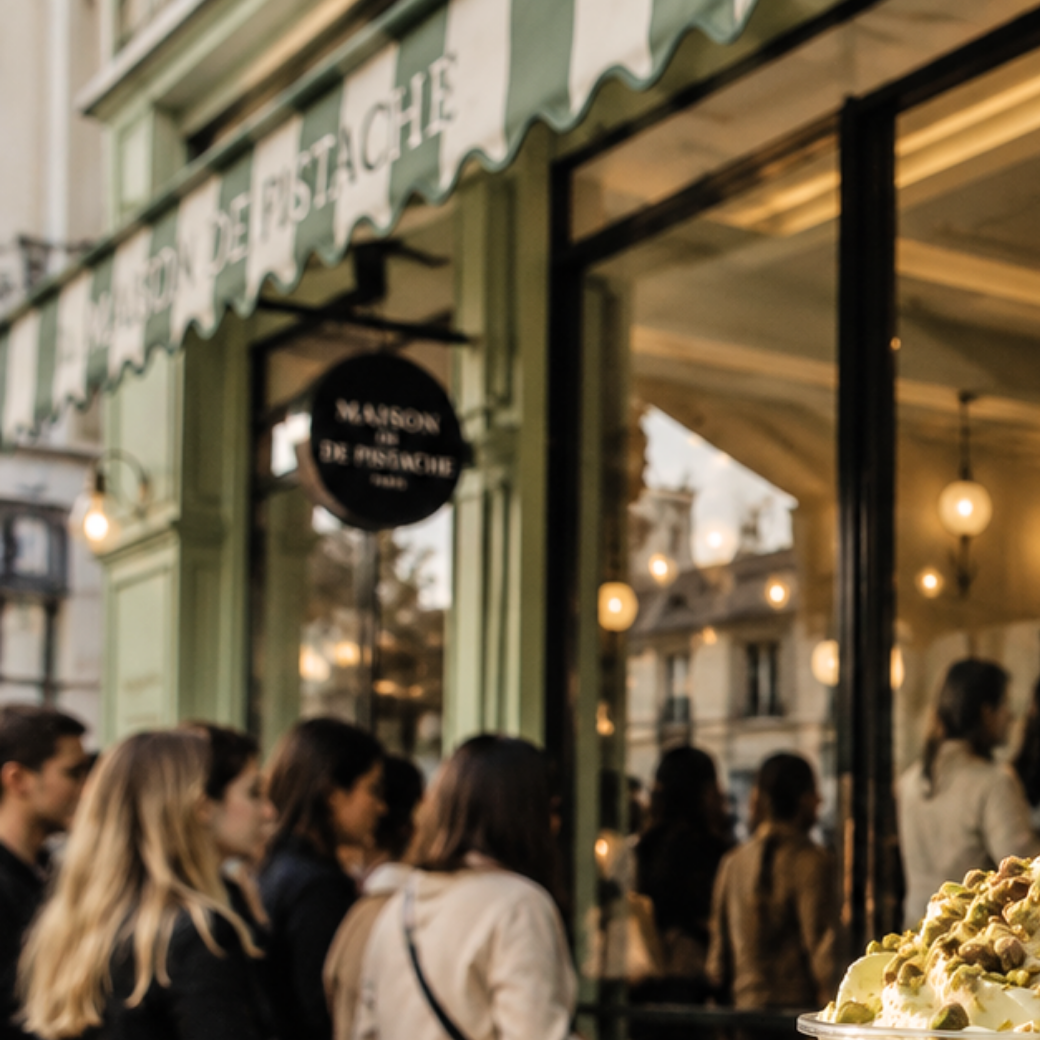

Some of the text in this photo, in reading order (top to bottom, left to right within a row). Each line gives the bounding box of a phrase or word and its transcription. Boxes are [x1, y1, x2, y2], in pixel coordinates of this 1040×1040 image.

[209, 192, 250, 276] DE
[257, 52, 458, 244] PISTACHE
[335, 397, 441, 436] MAISON
